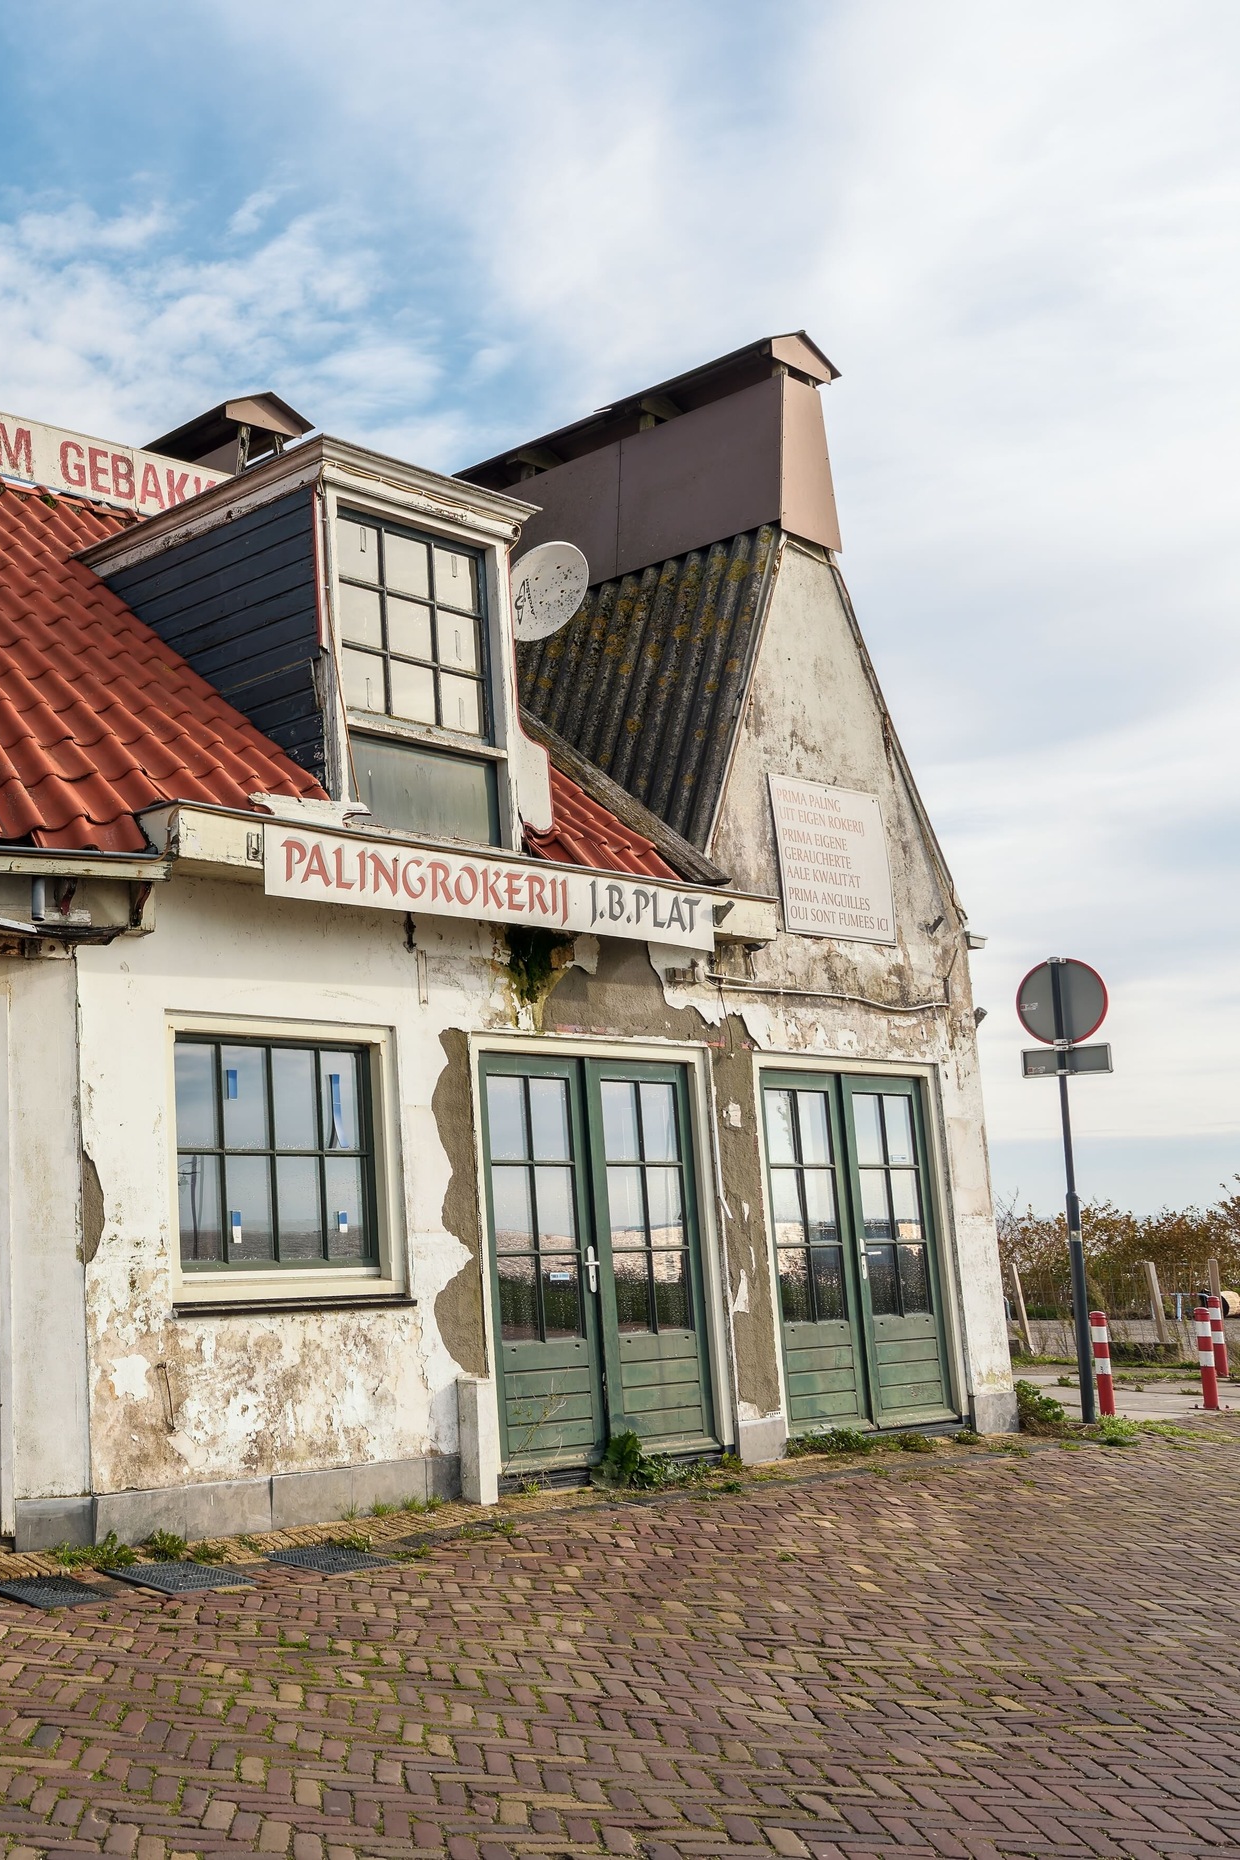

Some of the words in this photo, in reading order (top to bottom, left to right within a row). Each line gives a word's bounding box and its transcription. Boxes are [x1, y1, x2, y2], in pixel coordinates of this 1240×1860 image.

[776, 788, 808, 806] PRIMA
[809, 794, 841, 813] PALING
[779, 806, 796, 821] UIT
[798, 809, 826, 827] EIGEN
[782, 827, 813, 846] PRIMA
[814, 833, 848, 851] EIGENE
[784, 846, 852, 870] GERAUCHERTE
[280, 837, 569, 927] PALINGROKERIJ
[786, 864, 811, 881] AALE
[812, 868, 861, 889] KWALITÄT
[788, 886, 819, 904] PRIMA
[821, 892, 871, 912] ANGUILLES
[810, 908, 836, 924] SONT
[839, 912, 875, 930] FUMEES
[877, 917, 889, 932] ICI
